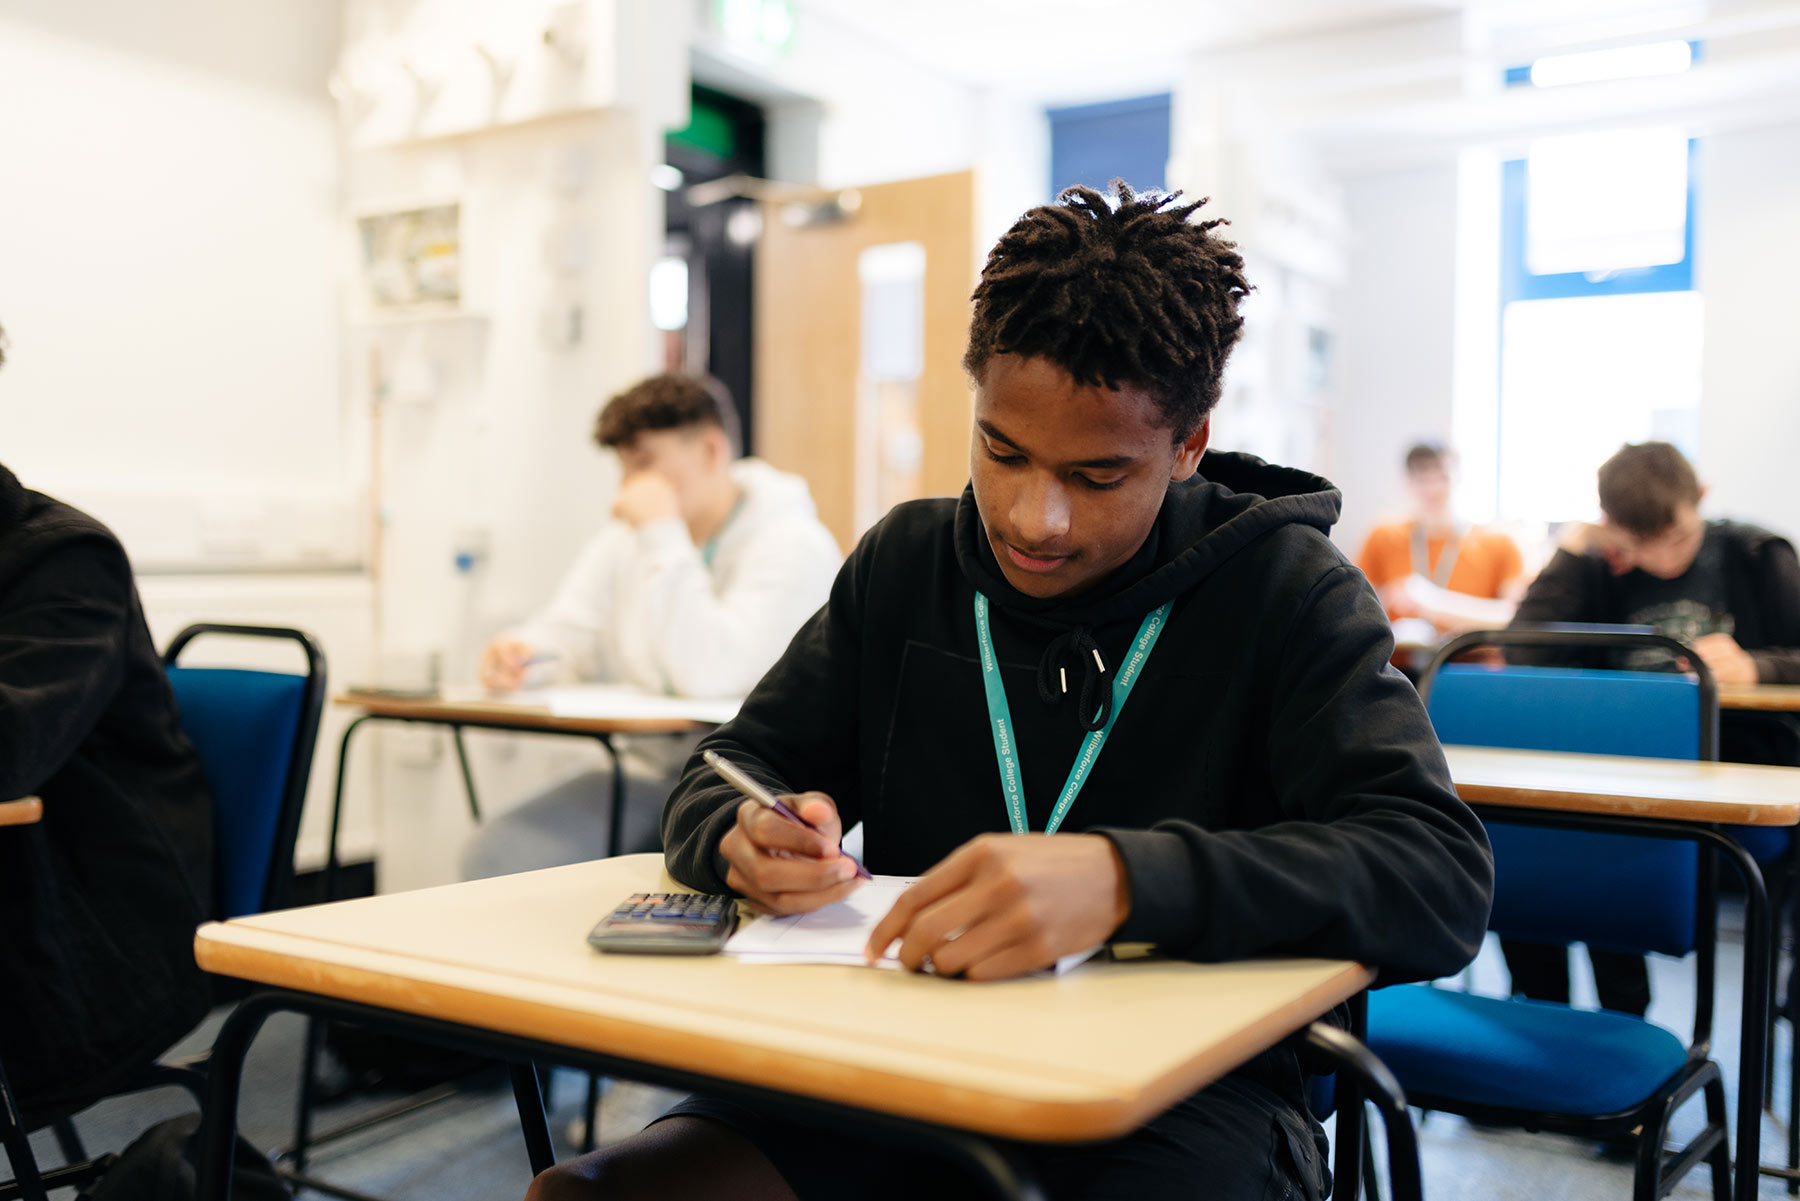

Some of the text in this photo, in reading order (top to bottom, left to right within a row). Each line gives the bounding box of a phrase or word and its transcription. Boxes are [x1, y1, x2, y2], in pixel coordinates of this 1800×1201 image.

[980, 619, 993, 673] Wilberforce
[1138, 617, 1161, 650] College
[1120, 651, 1144, 687] Student
[997, 718, 1024, 835] berforce College Student
[1074, 730, 1104, 781] Wilberforce
[1057, 781, 1079, 815] College
